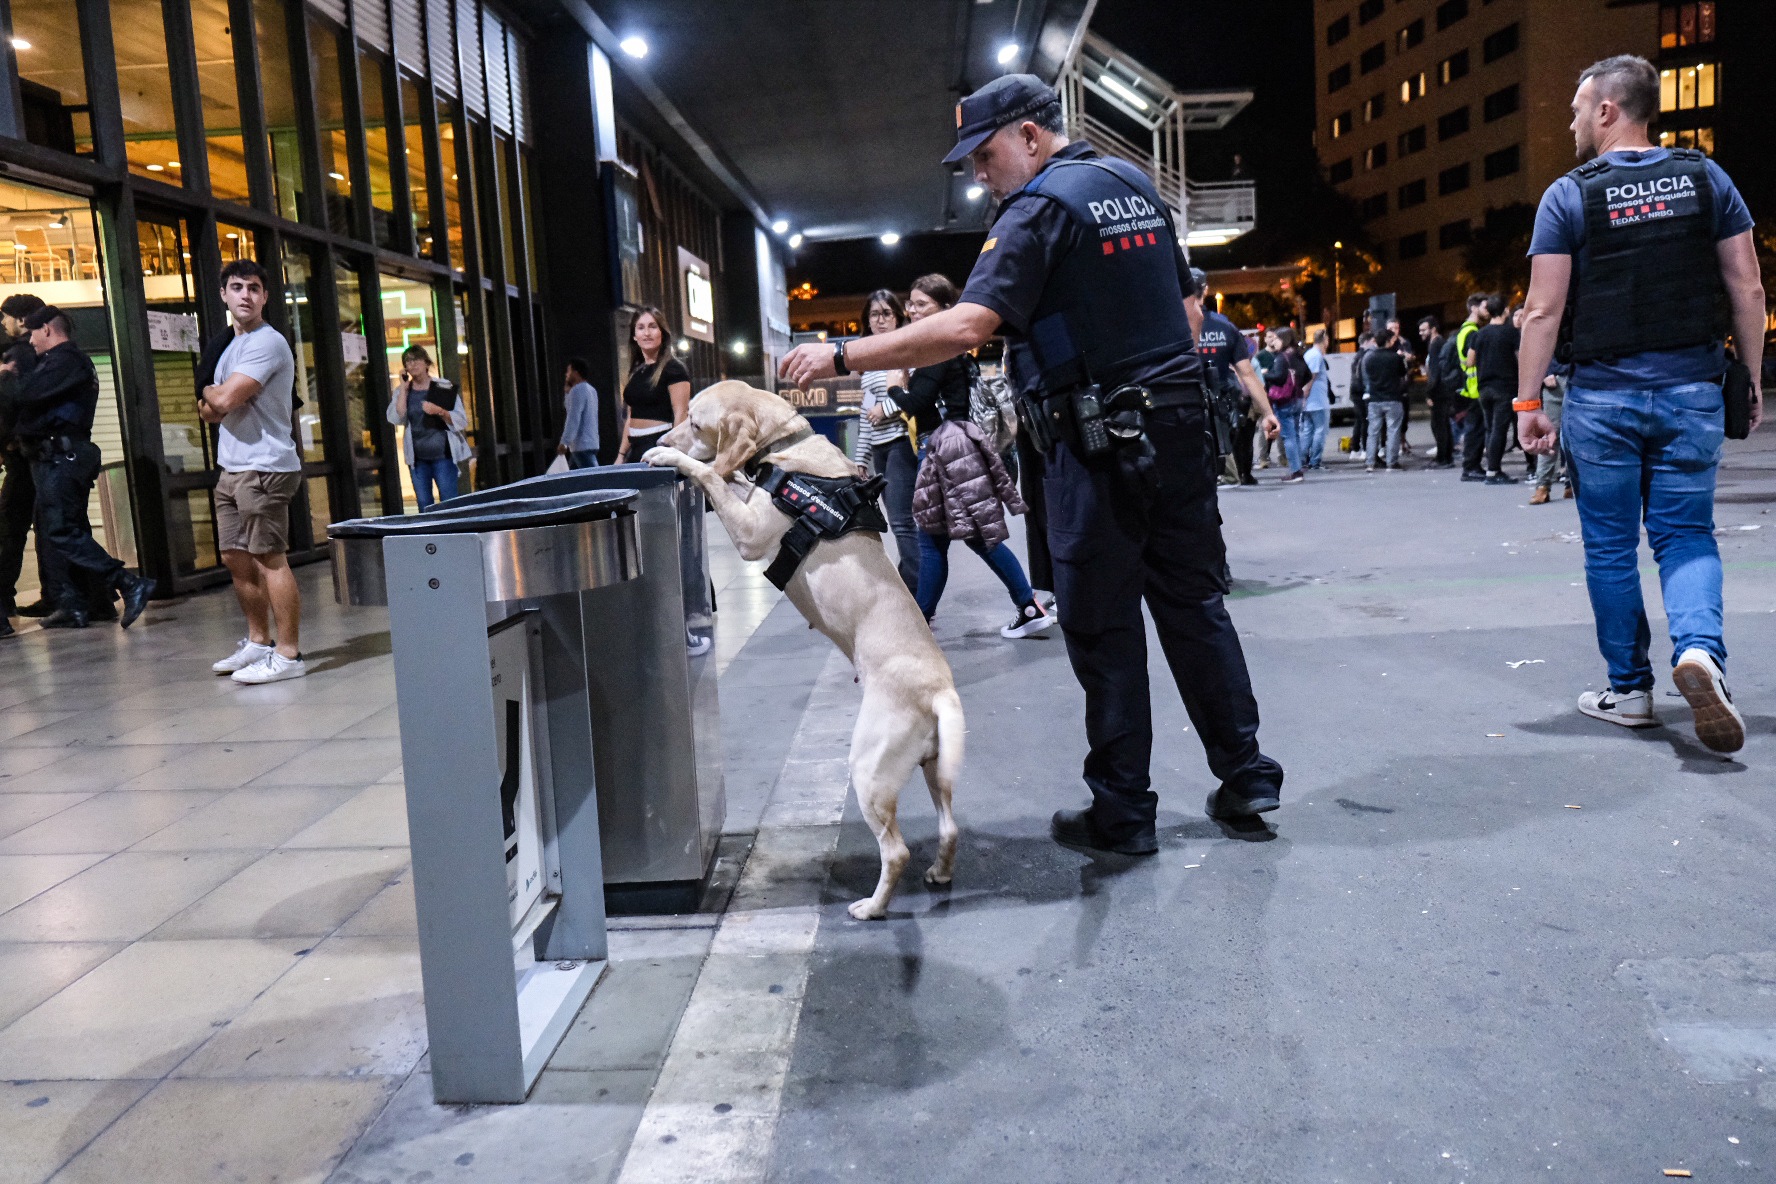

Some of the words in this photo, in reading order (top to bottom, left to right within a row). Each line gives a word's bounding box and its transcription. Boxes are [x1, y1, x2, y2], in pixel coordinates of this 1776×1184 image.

[1606, 175, 1694, 202] POLICIA
[1608, 199, 1643, 210] mossos
[1646, 191, 1695, 203] d'esquadra
[1099, 222, 1131, 238] mossos
[1131, 216, 1166, 231] d'esquadra
[1611, 216, 1640, 225] TEDAX
[1649, 209, 1673, 218] NRBQ
[1200, 331, 1226, 341] LICIA
[786, 479, 811, 498] mossos
[811, 495, 845, 521] d'esquadra
